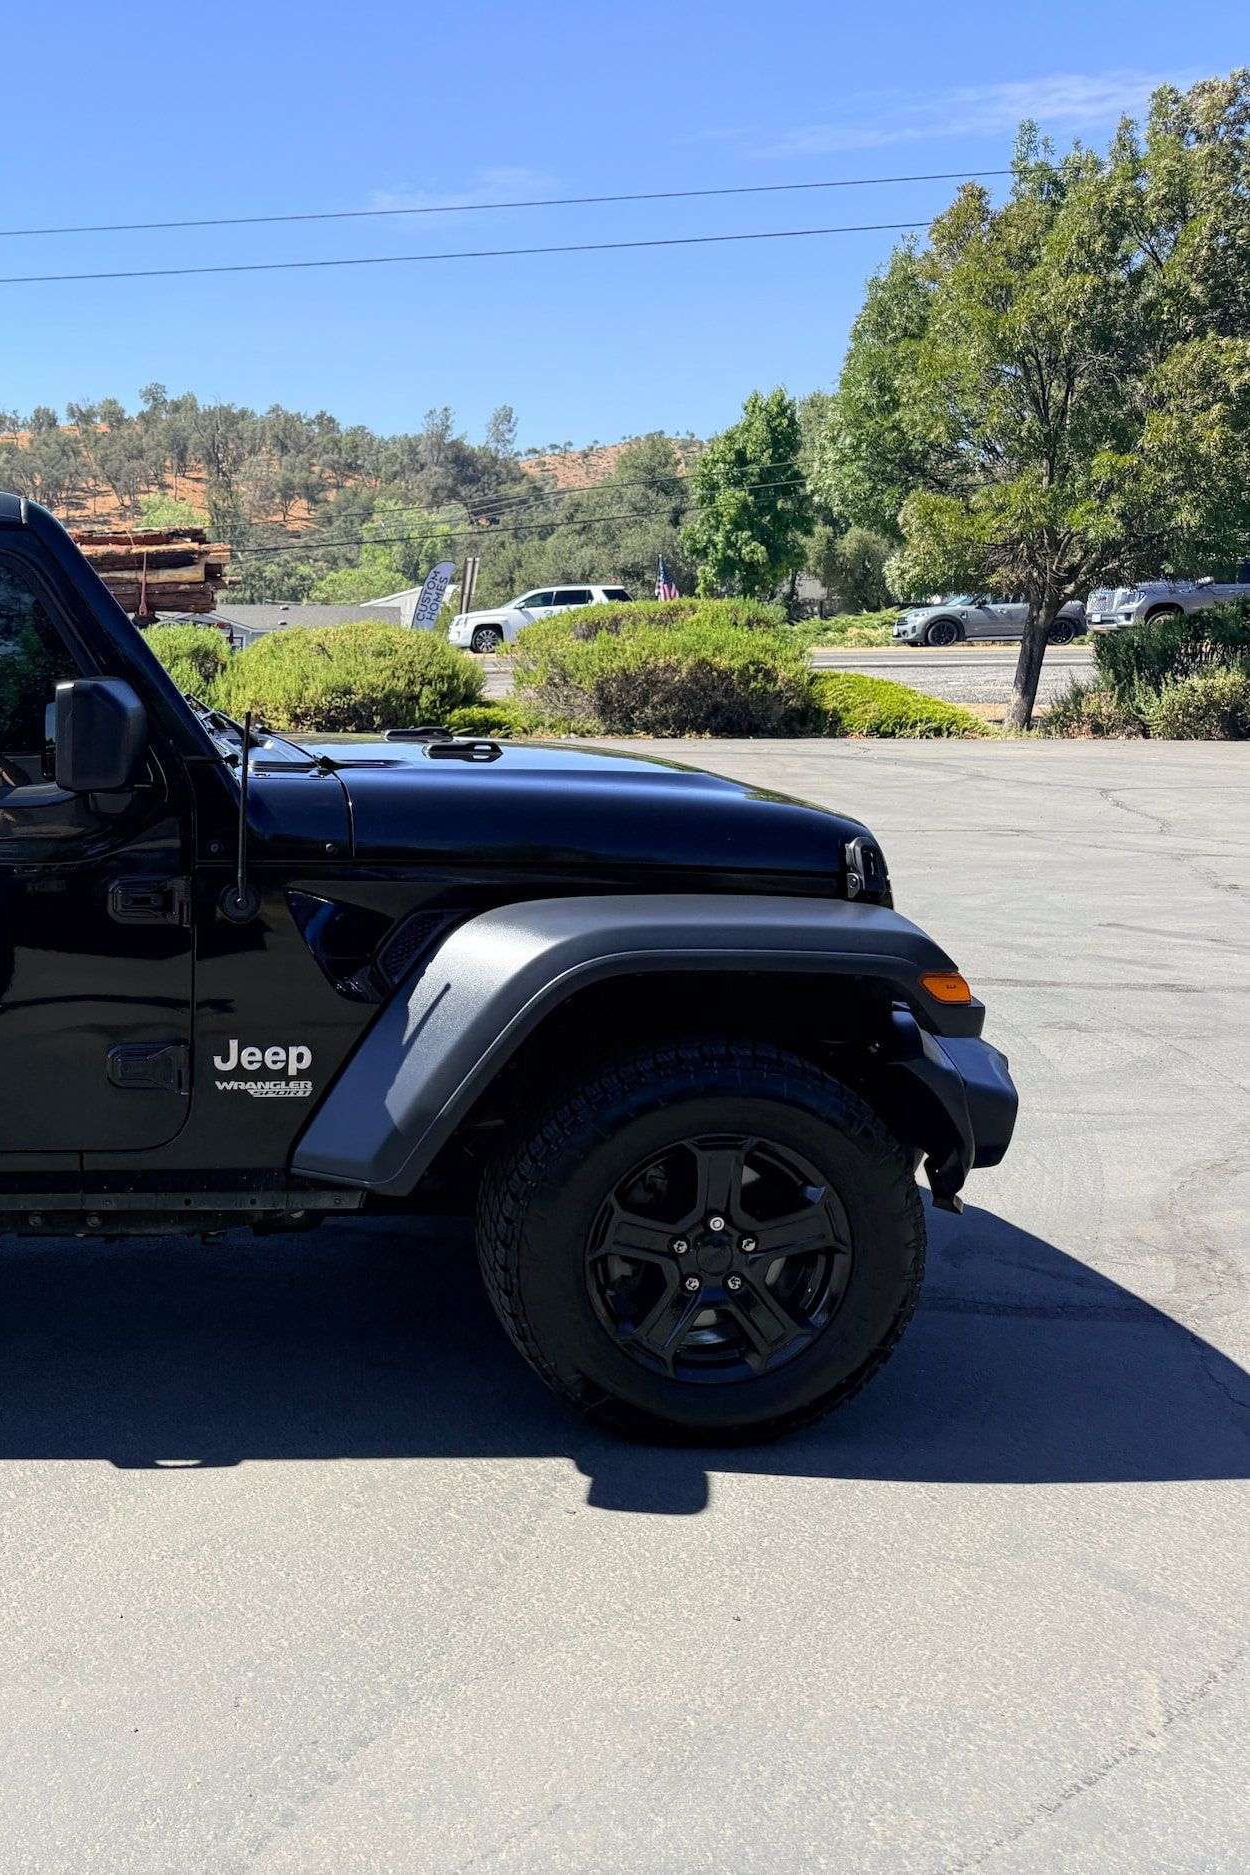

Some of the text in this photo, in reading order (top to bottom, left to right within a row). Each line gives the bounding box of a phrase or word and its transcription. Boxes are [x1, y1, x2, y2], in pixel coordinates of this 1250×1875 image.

[416, 570, 441, 621] CUSTOM
[426, 576, 448, 621] HOMES
[213, 1039, 312, 1076] Jeep
[215, 1081, 313, 1090] WRANGLER
